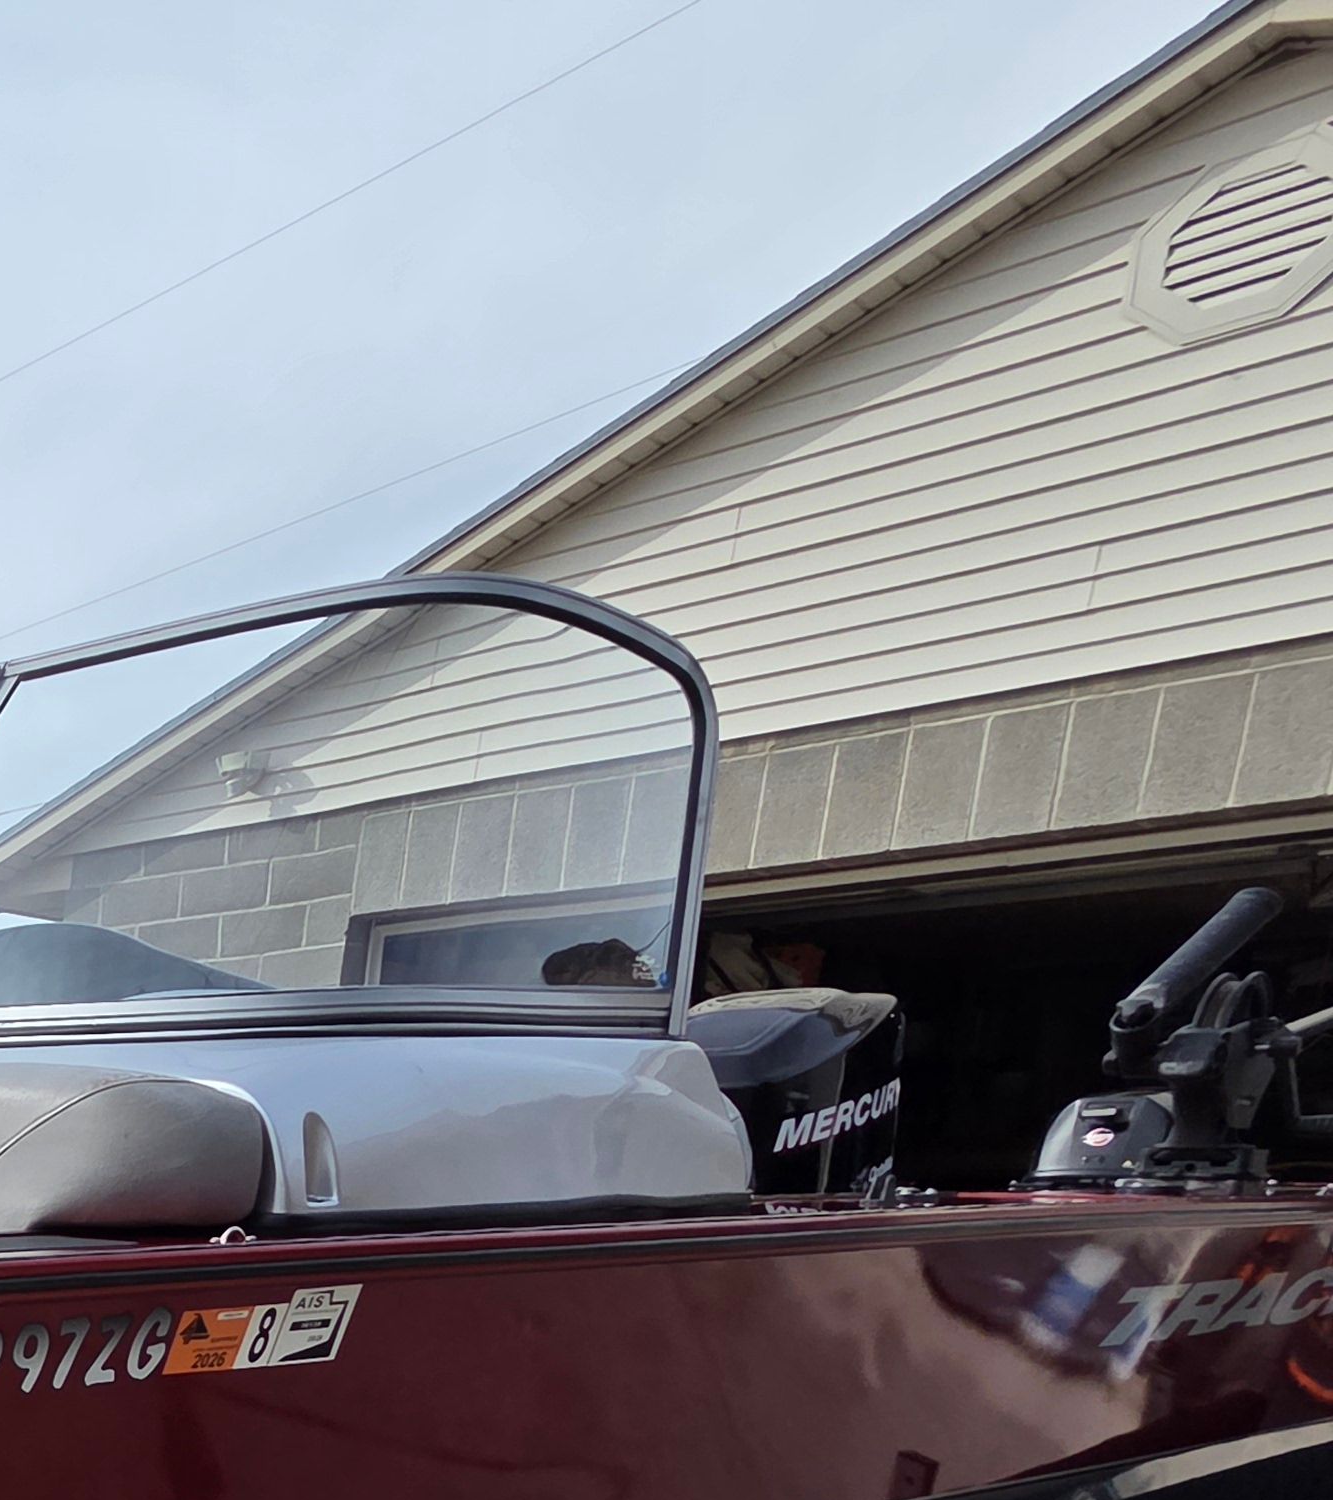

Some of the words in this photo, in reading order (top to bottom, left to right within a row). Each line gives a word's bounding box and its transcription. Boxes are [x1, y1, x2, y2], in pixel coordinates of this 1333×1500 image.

[295, 1295, 325, 1310] AIS
[1098, 1266, 1333, 1348] TRAC
[248, 1307, 277, 1364] 8
[191, 1352, 226, 1369] 2026
